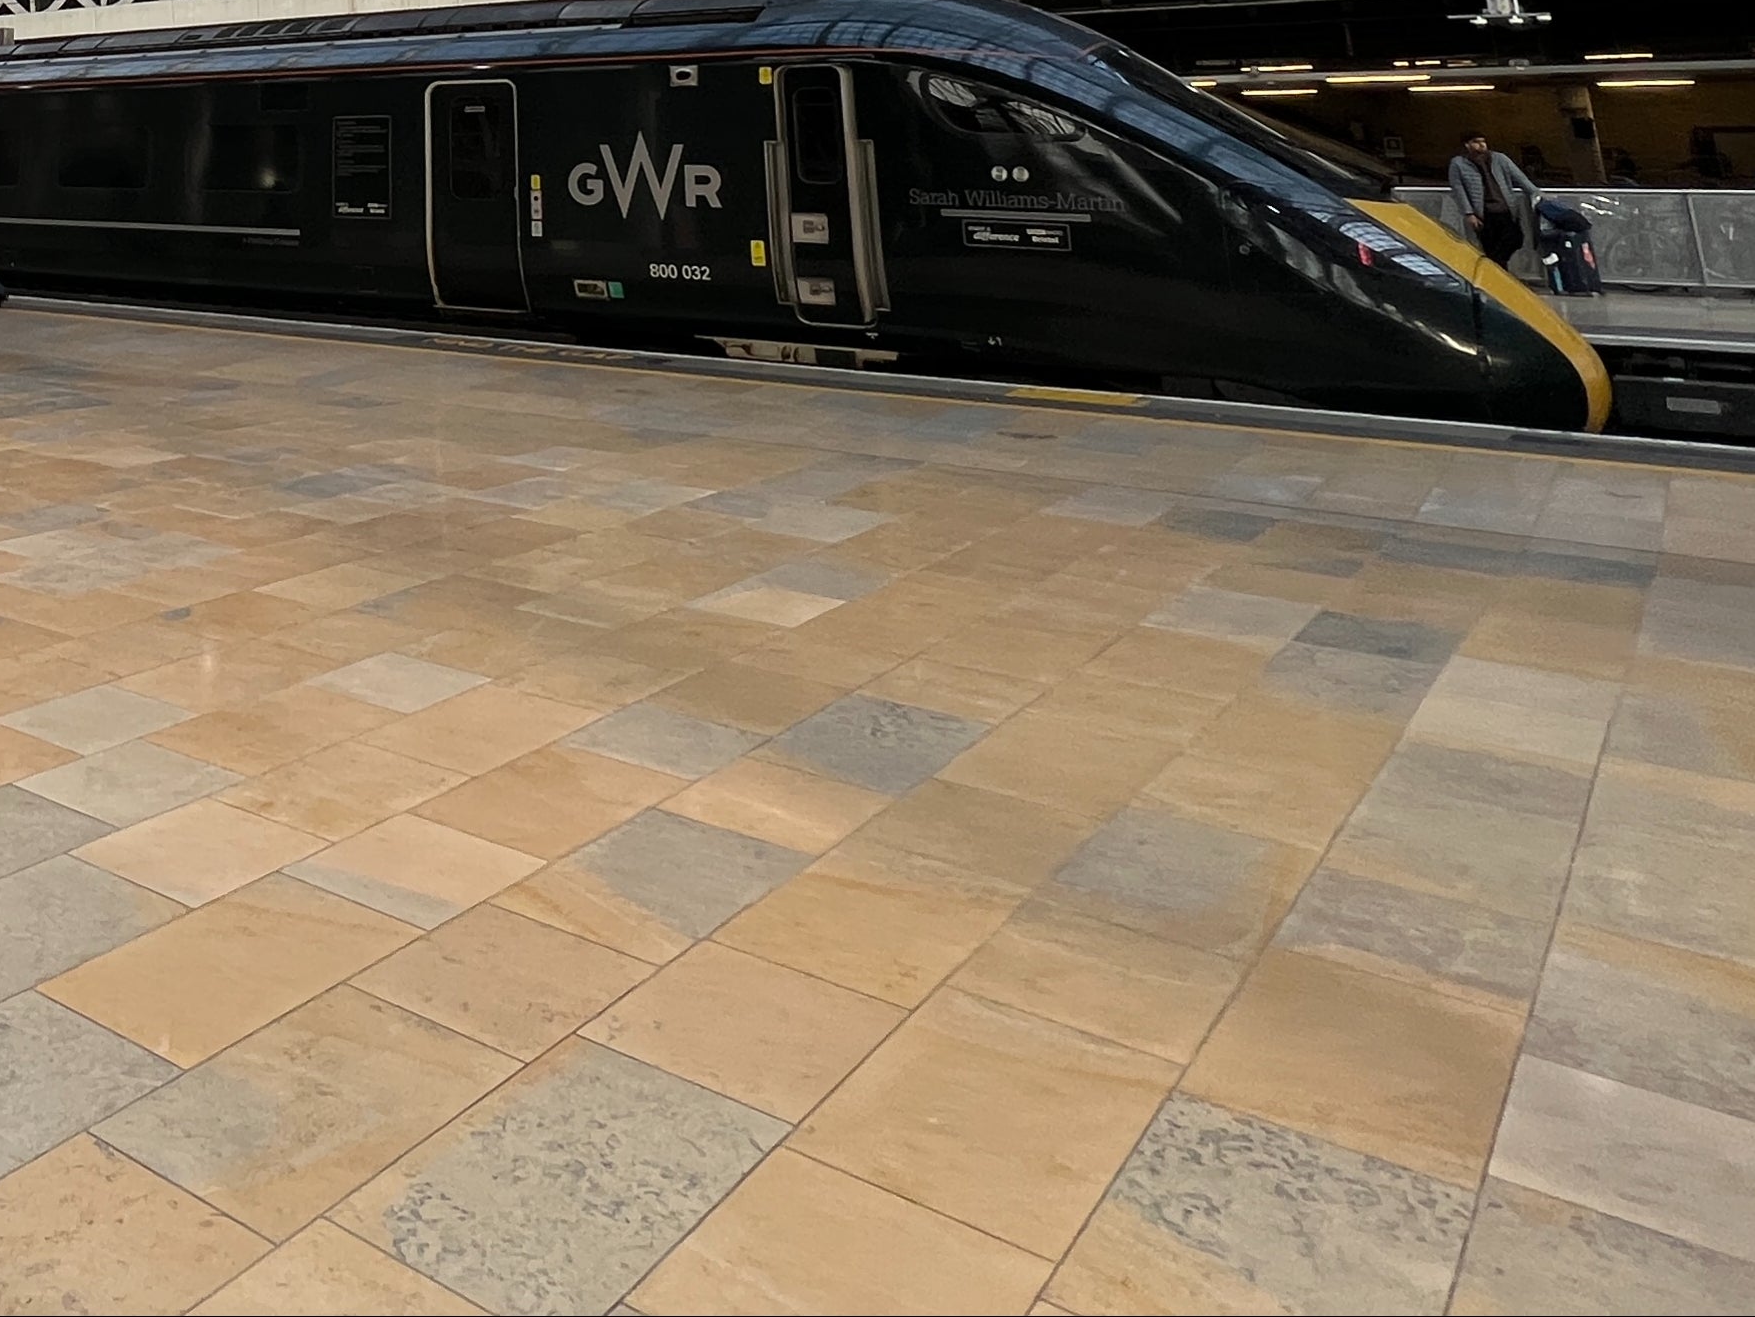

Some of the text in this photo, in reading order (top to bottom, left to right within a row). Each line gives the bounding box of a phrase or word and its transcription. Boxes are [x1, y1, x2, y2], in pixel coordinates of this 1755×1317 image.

[568, 131, 723, 220] GWR
[909, 188, 1126, 213] Sarah Williams-Martin
[649, 264, 711, 281] 800 032
